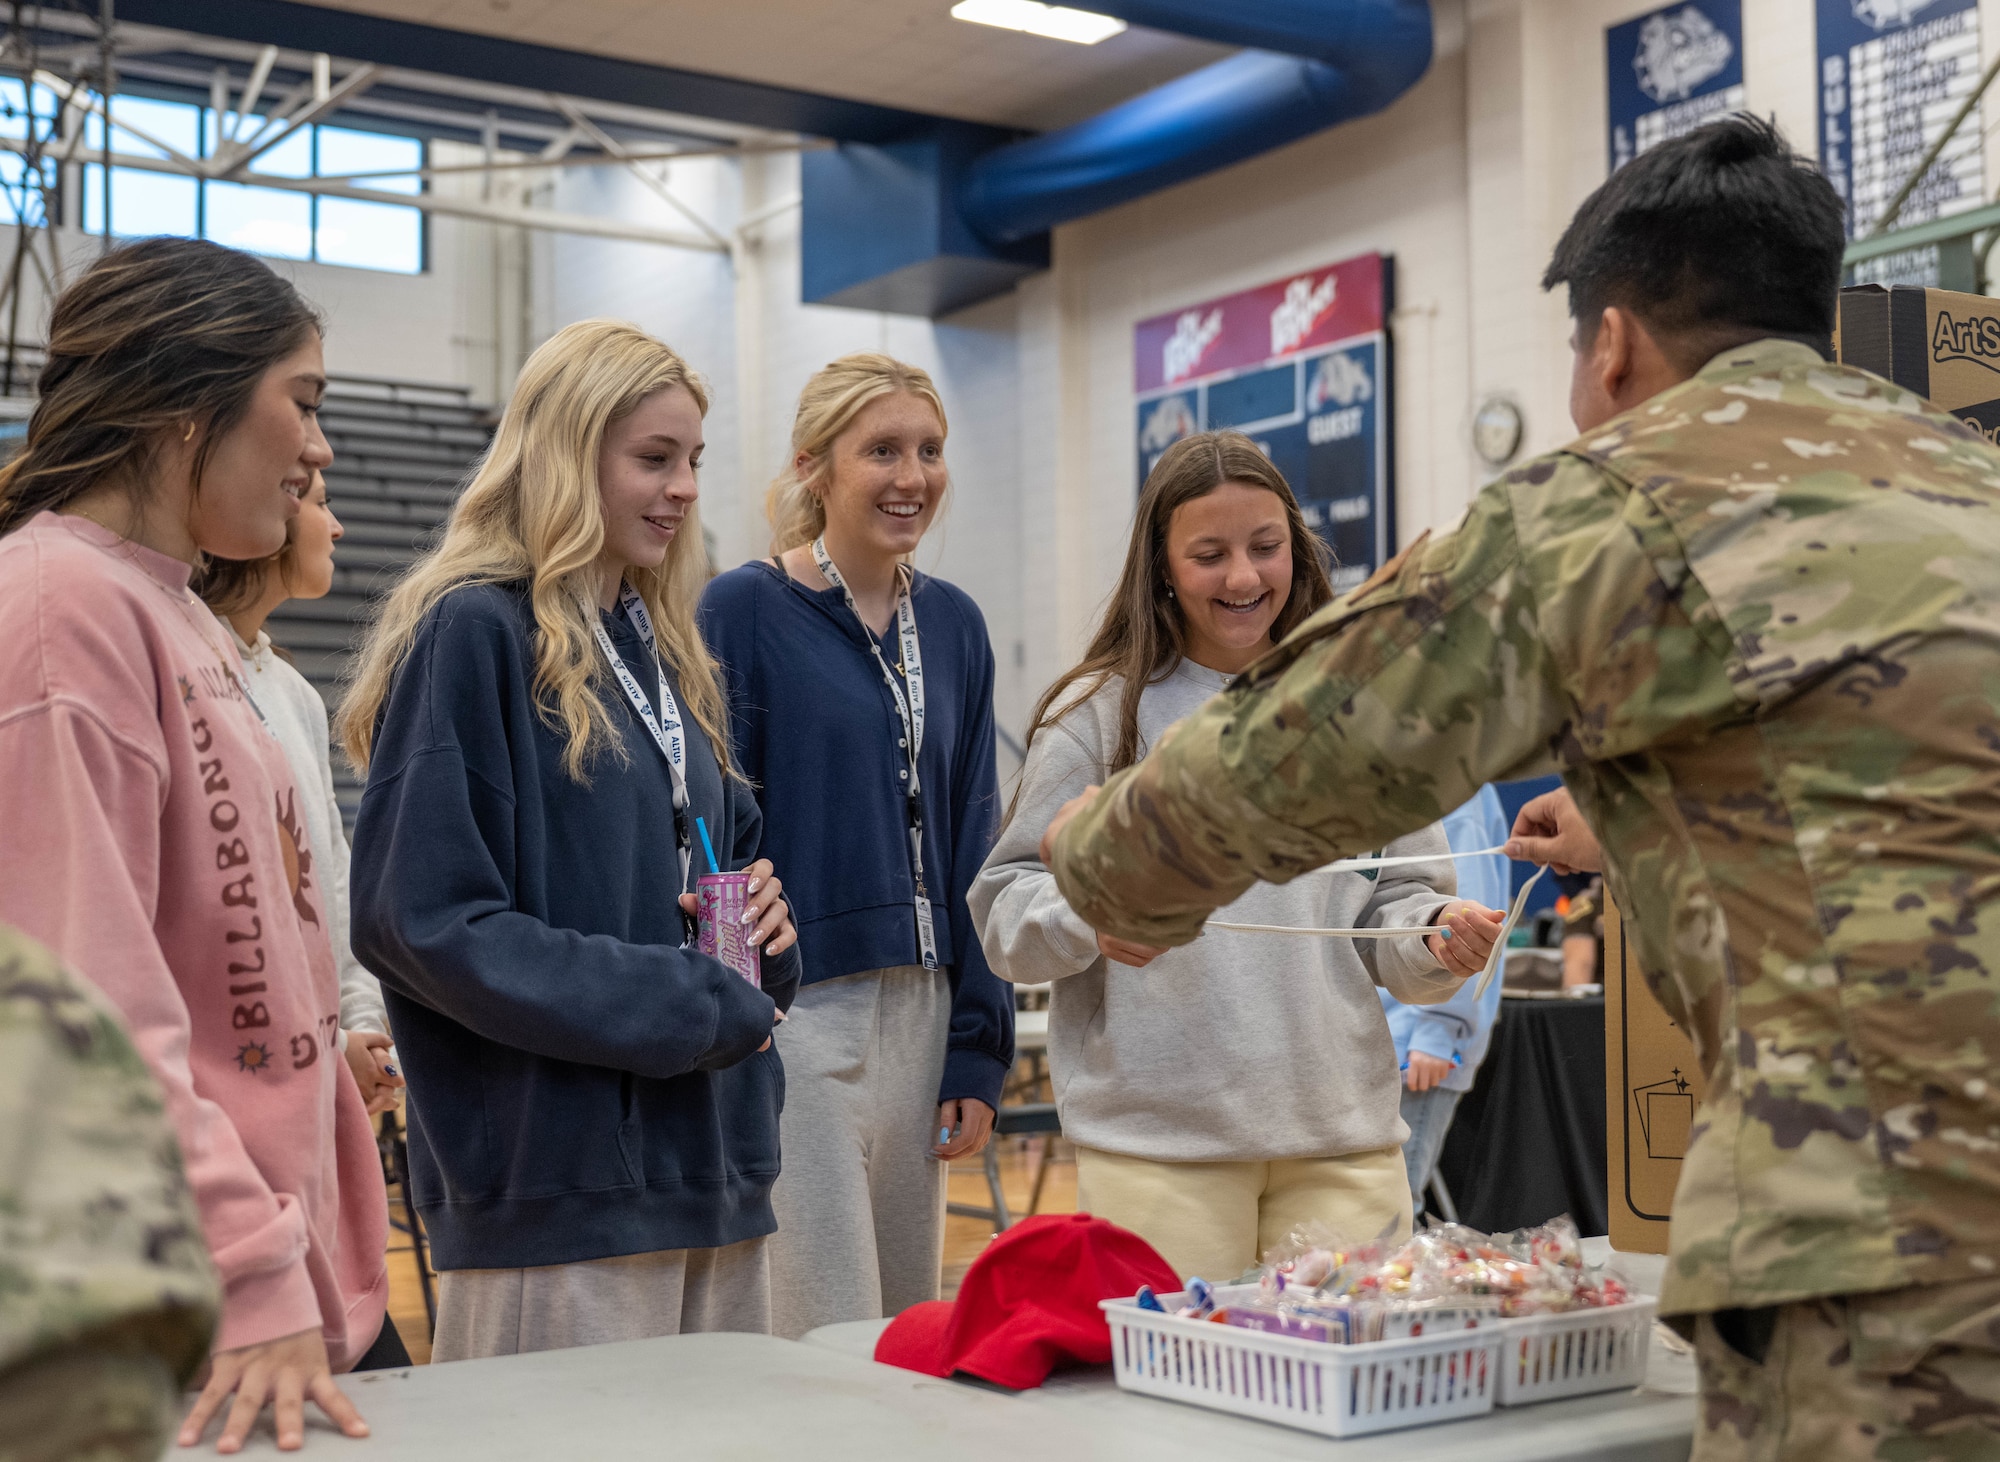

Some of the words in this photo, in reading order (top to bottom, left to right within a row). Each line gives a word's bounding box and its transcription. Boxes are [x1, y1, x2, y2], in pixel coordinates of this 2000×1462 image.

[1308, 405, 1364, 445] GUEST
[635, 609, 649, 633] ALTUS
[905, 640, 914, 662] ALTUS
[621, 675, 641, 700] ALTUS
[911, 680, 919, 703] ALTUS
[665, 690, 676, 716] ALTUS
[671, 736, 681, 764] ALTUS
[192, 717, 270, 1030] BILLABONG
